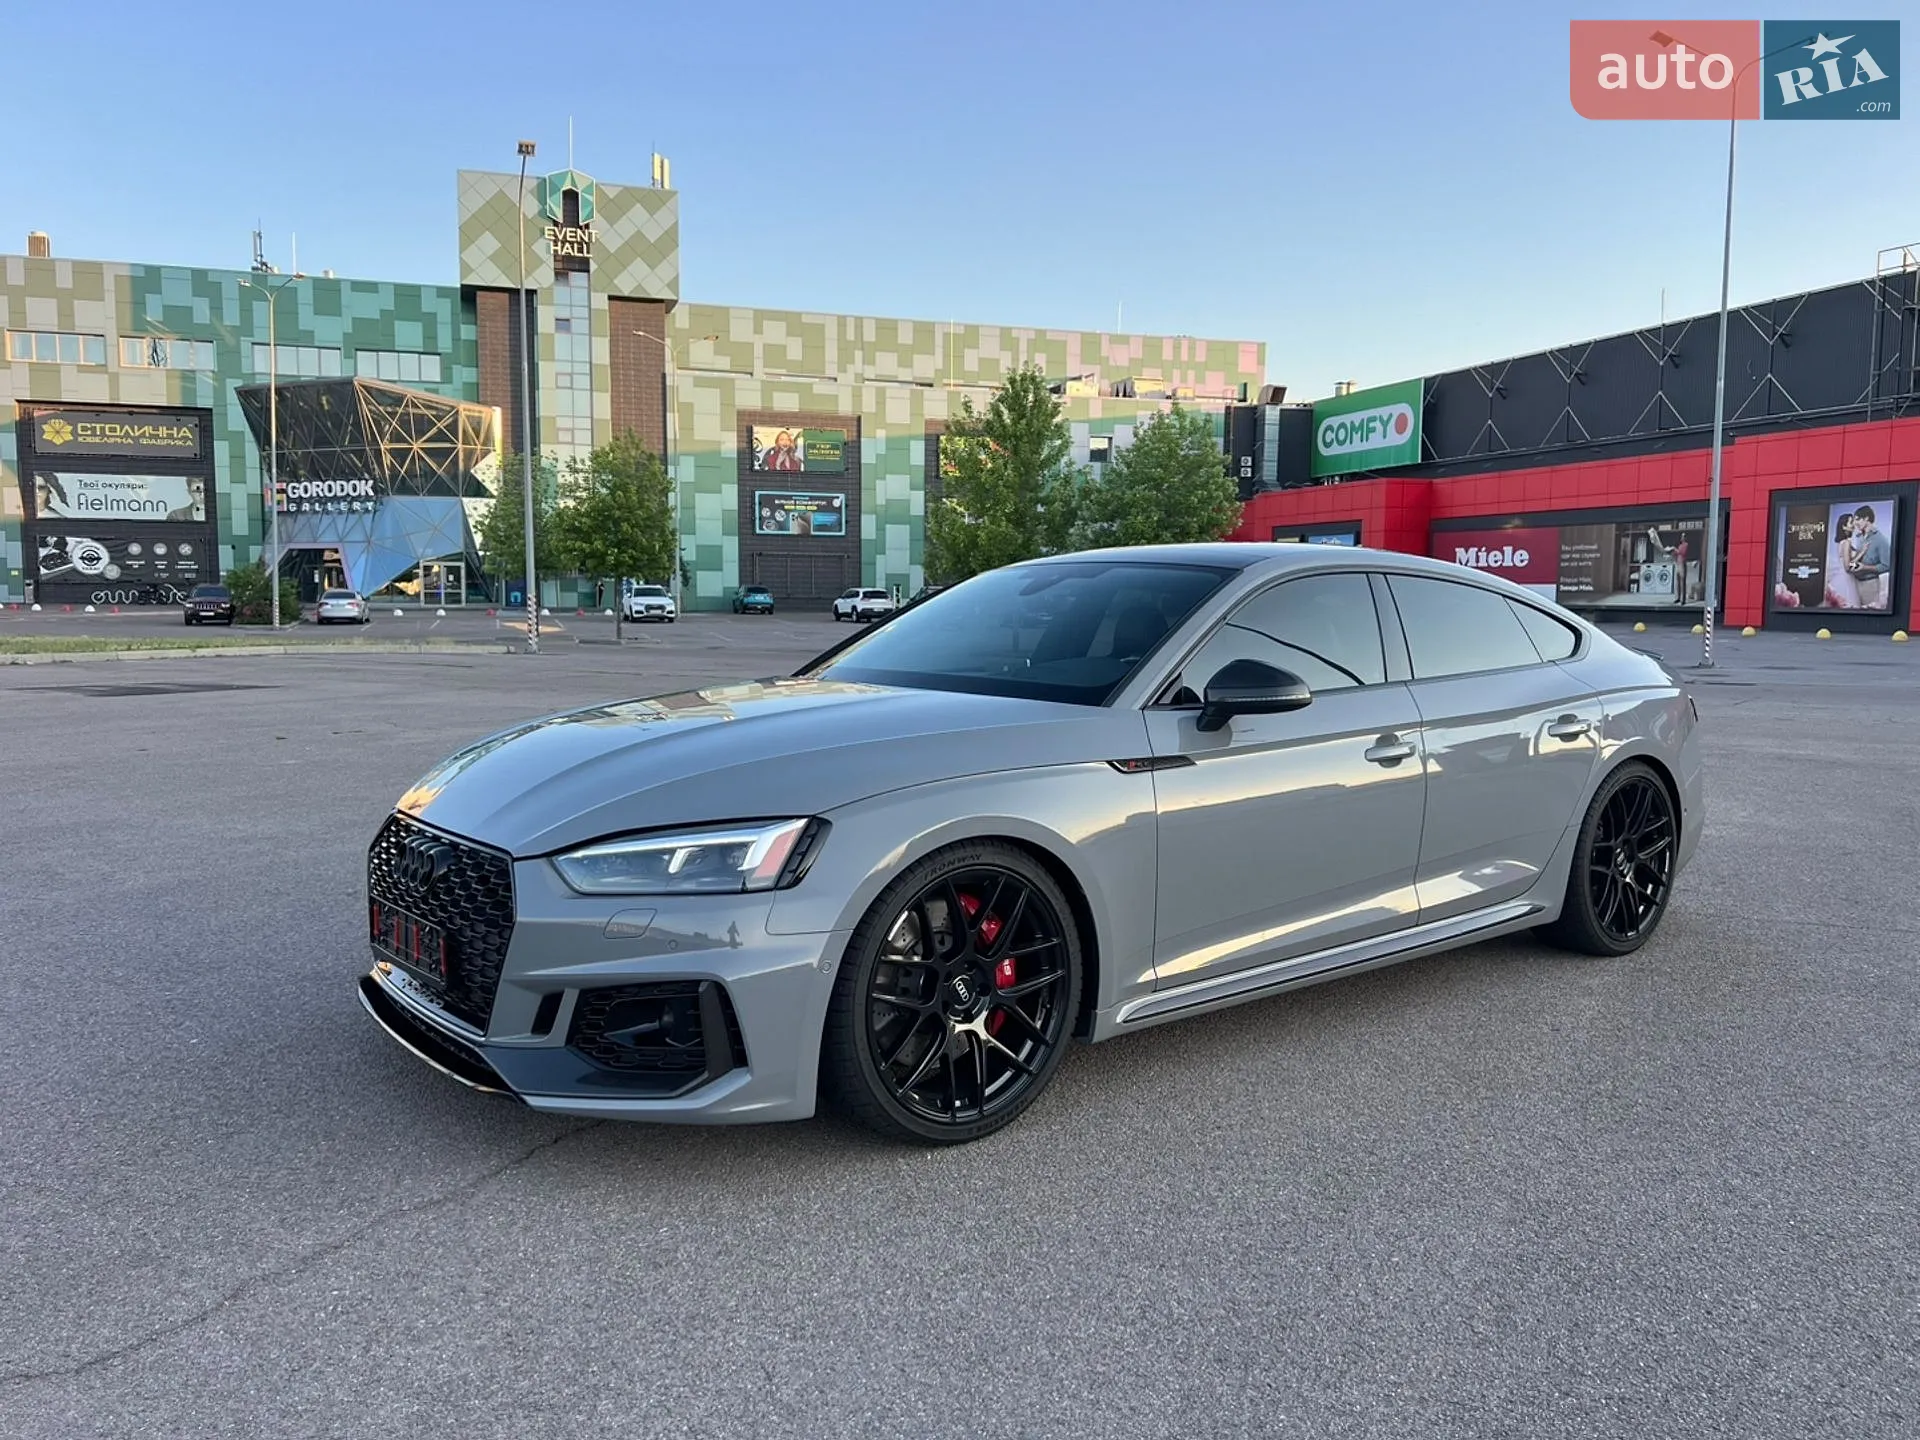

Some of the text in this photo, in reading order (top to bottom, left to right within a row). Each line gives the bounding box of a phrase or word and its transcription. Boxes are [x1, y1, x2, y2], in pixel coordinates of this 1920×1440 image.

[544, 226, 599, 243] EVENT
[550, 241, 593, 257] HALL
[77, 422, 193, 438] СТОЛИЧНА
[1322, 413, 1393, 449] COMFY
[287, 480, 375, 498] GORODOK
[288, 501, 375, 512] GALLERY
[1455, 545, 1530, 568] Miele
